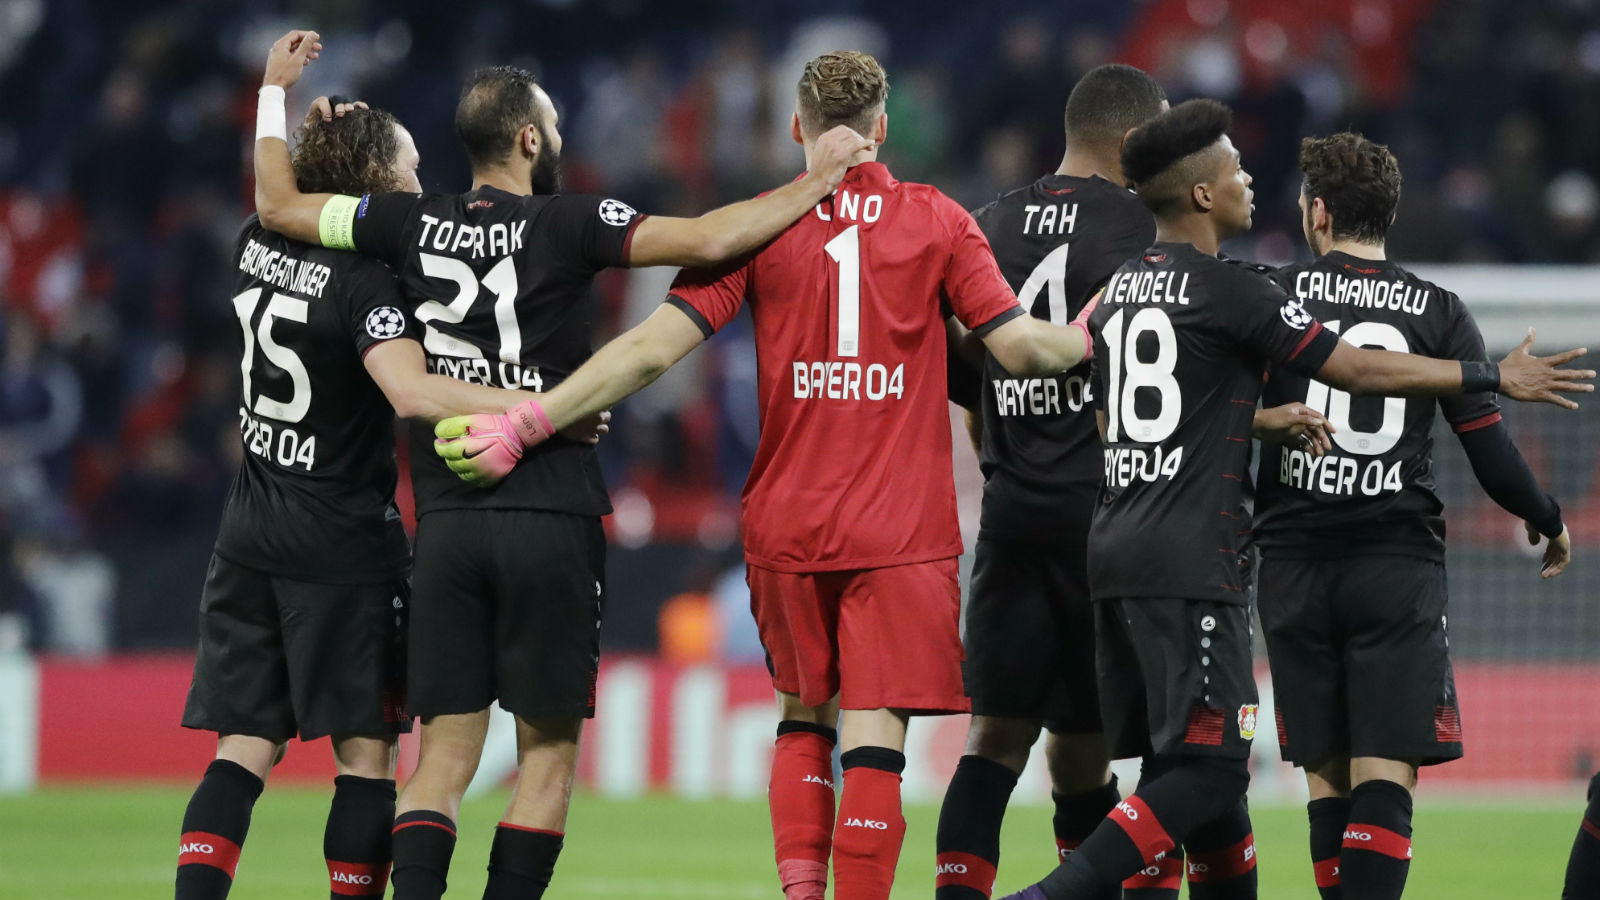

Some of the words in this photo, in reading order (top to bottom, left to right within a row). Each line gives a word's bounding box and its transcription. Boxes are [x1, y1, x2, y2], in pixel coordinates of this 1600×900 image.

[418, 213, 527, 259] TOPRAK
[1023, 203, 1078, 235] TAH
[824, 224, 861, 357] 1
[1016, 243, 1069, 327] 4
[1295, 271, 1430, 316] ÇALHANOĞLU
[414, 252, 521, 364] 21
[232, 287, 312, 424] 15
[498, 361, 543, 393] 04
[1101, 307, 1182, 443] 18
[792, 361, 862, 401] BAYER
[865, 362, 905, 401] 04
[992, 378, 1062, 416] BAYER
[277, 428, 316, 472] 04
[1104, 448, 1148, 488] AYER
[1280, 445, 1357, 496] BAYER
[1360, 459, 1403, 497] 04
[843, 817, 888, 831] JAKO
[332, 871, 373, 885] JAKO
